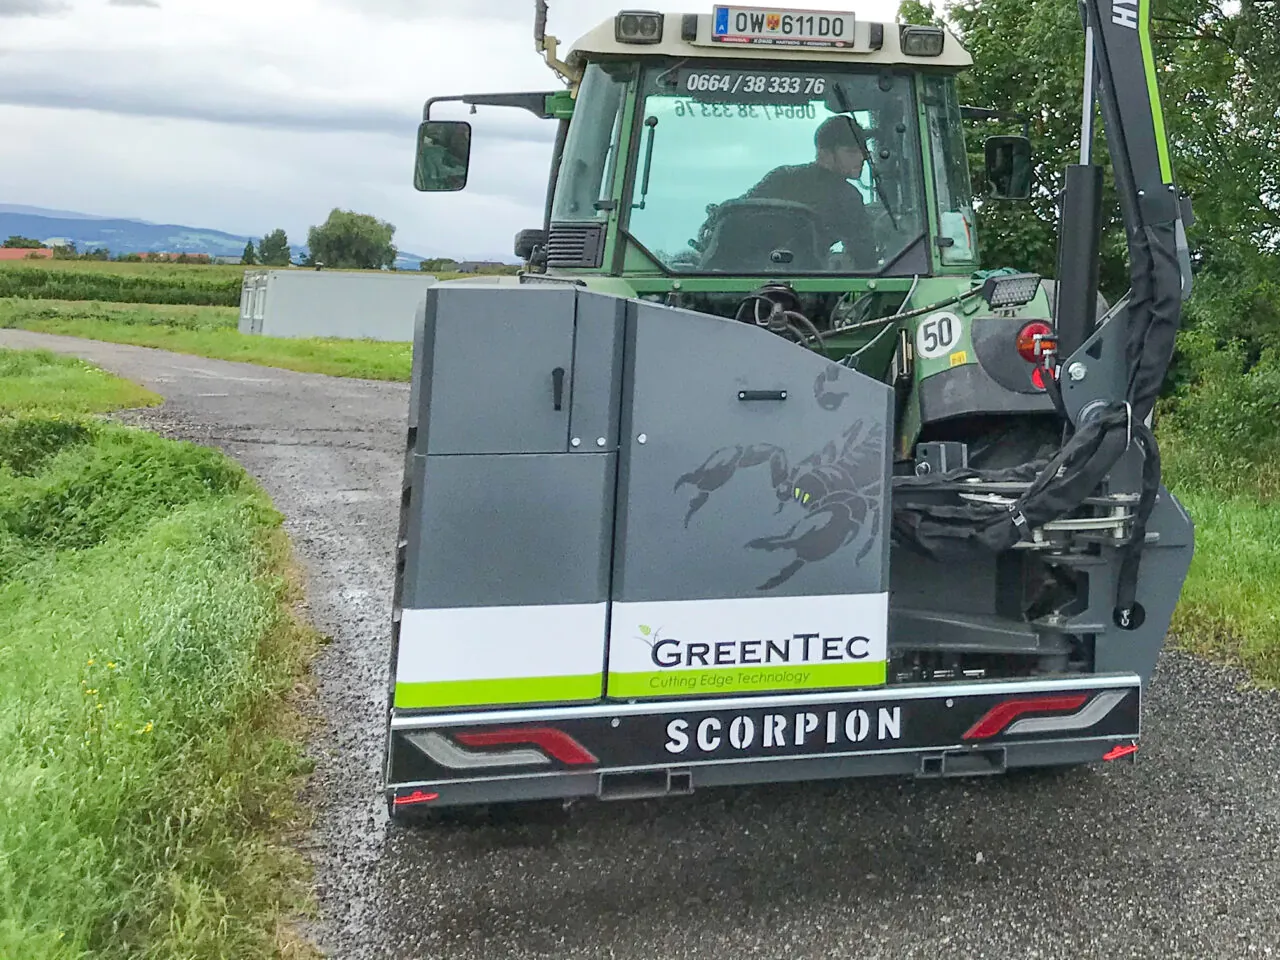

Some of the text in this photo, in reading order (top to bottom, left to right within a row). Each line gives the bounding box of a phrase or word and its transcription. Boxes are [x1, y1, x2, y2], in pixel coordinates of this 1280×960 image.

[735, 12, 765, 33] OW
[687, 74, 730, 91] 0664
[768, 77, 800, 93] 333
[804, 78, 825, 94] 76
[923, 317, 953, 352] 50
[649, 670, 811, 689] Cutting Edge Technology
[665, 706, 901, 753] SCORPION
